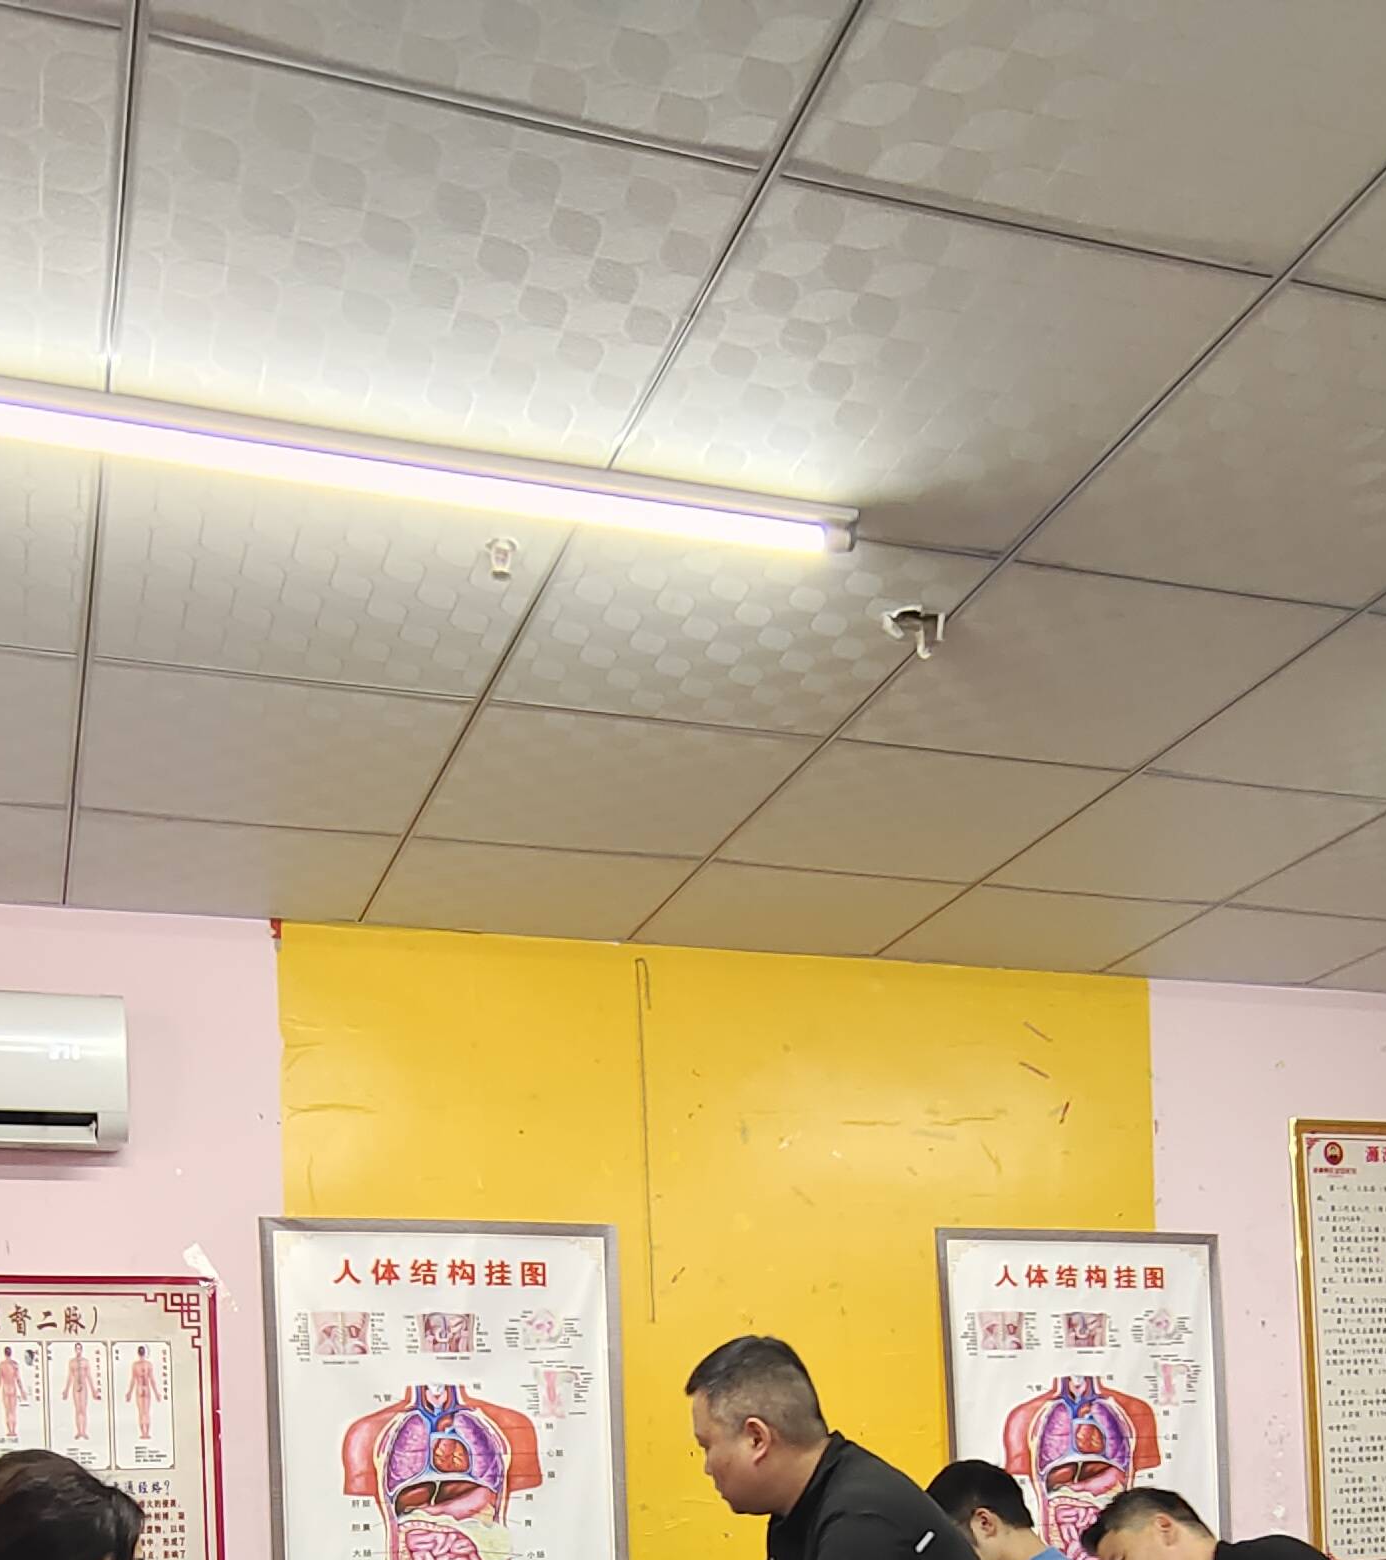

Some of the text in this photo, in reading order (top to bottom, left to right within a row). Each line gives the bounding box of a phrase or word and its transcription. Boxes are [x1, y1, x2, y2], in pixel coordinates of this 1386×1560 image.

[333, 1258, 548, 1288] 人体结构挂图
[995, 1264, 1166, 1290] 人体结构挂图
